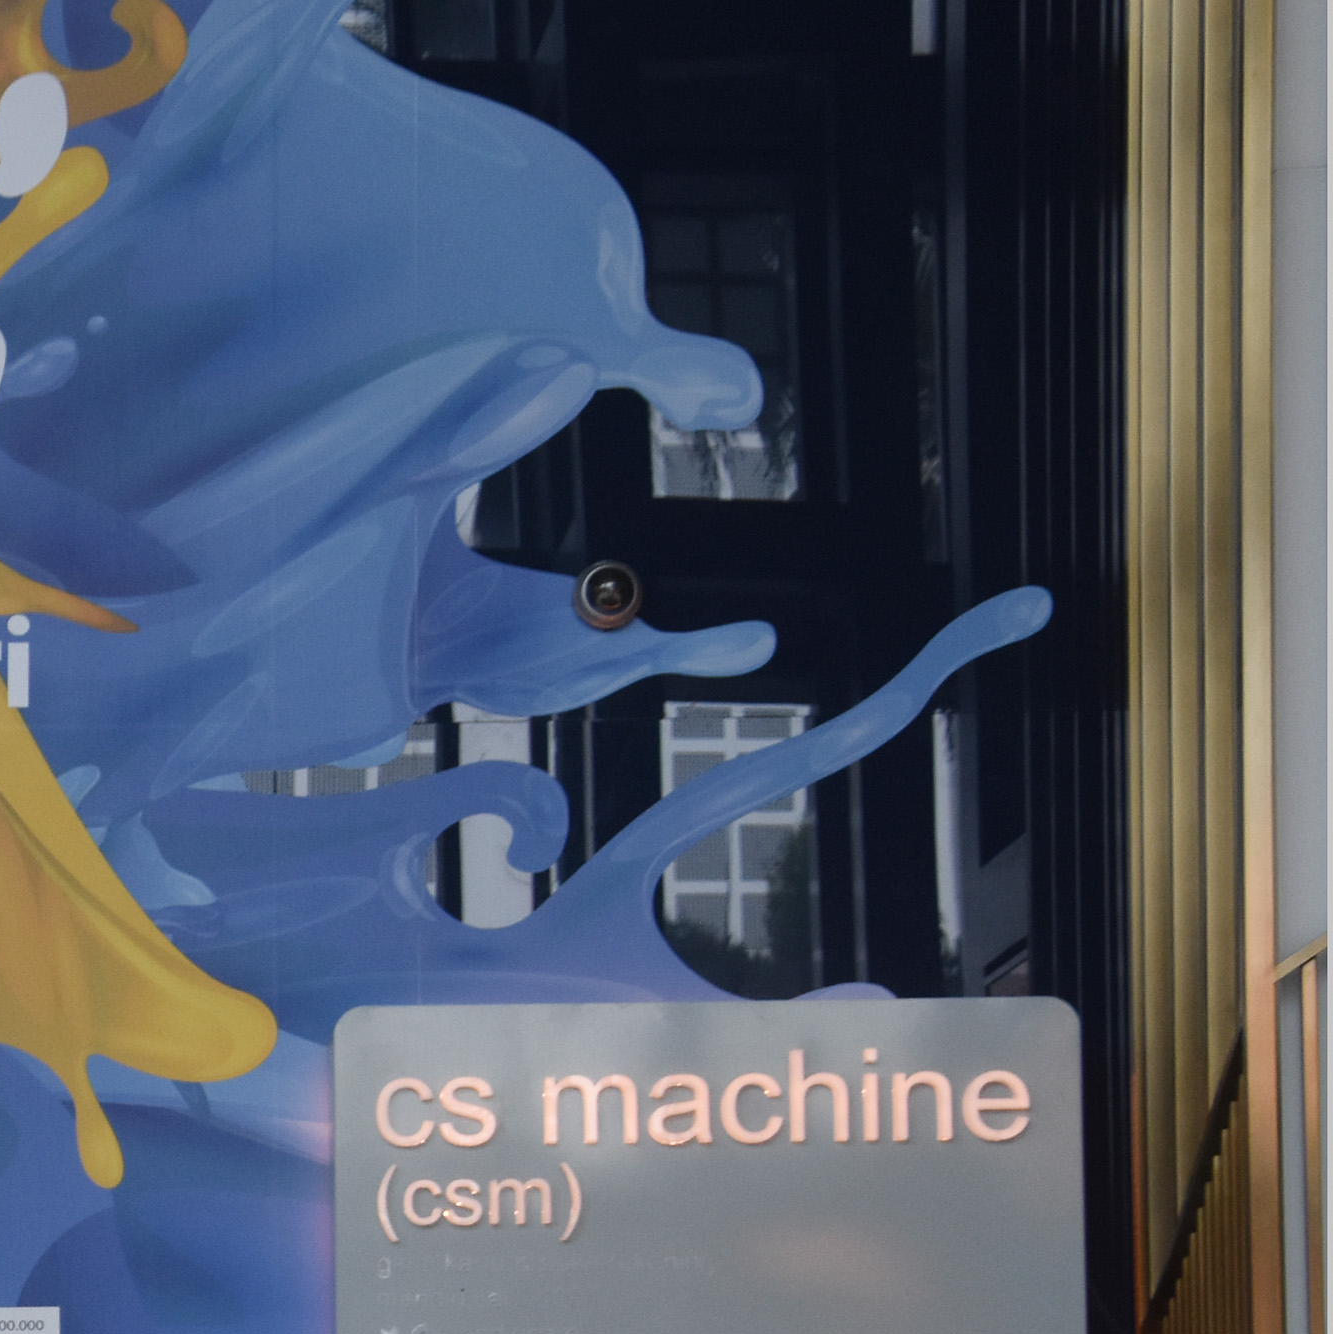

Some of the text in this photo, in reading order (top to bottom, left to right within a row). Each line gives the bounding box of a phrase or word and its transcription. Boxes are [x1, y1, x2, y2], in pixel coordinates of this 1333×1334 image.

[376, 1047, 1030, 1148] cs machine
[376, 1161, 582, 1243] (csm)
